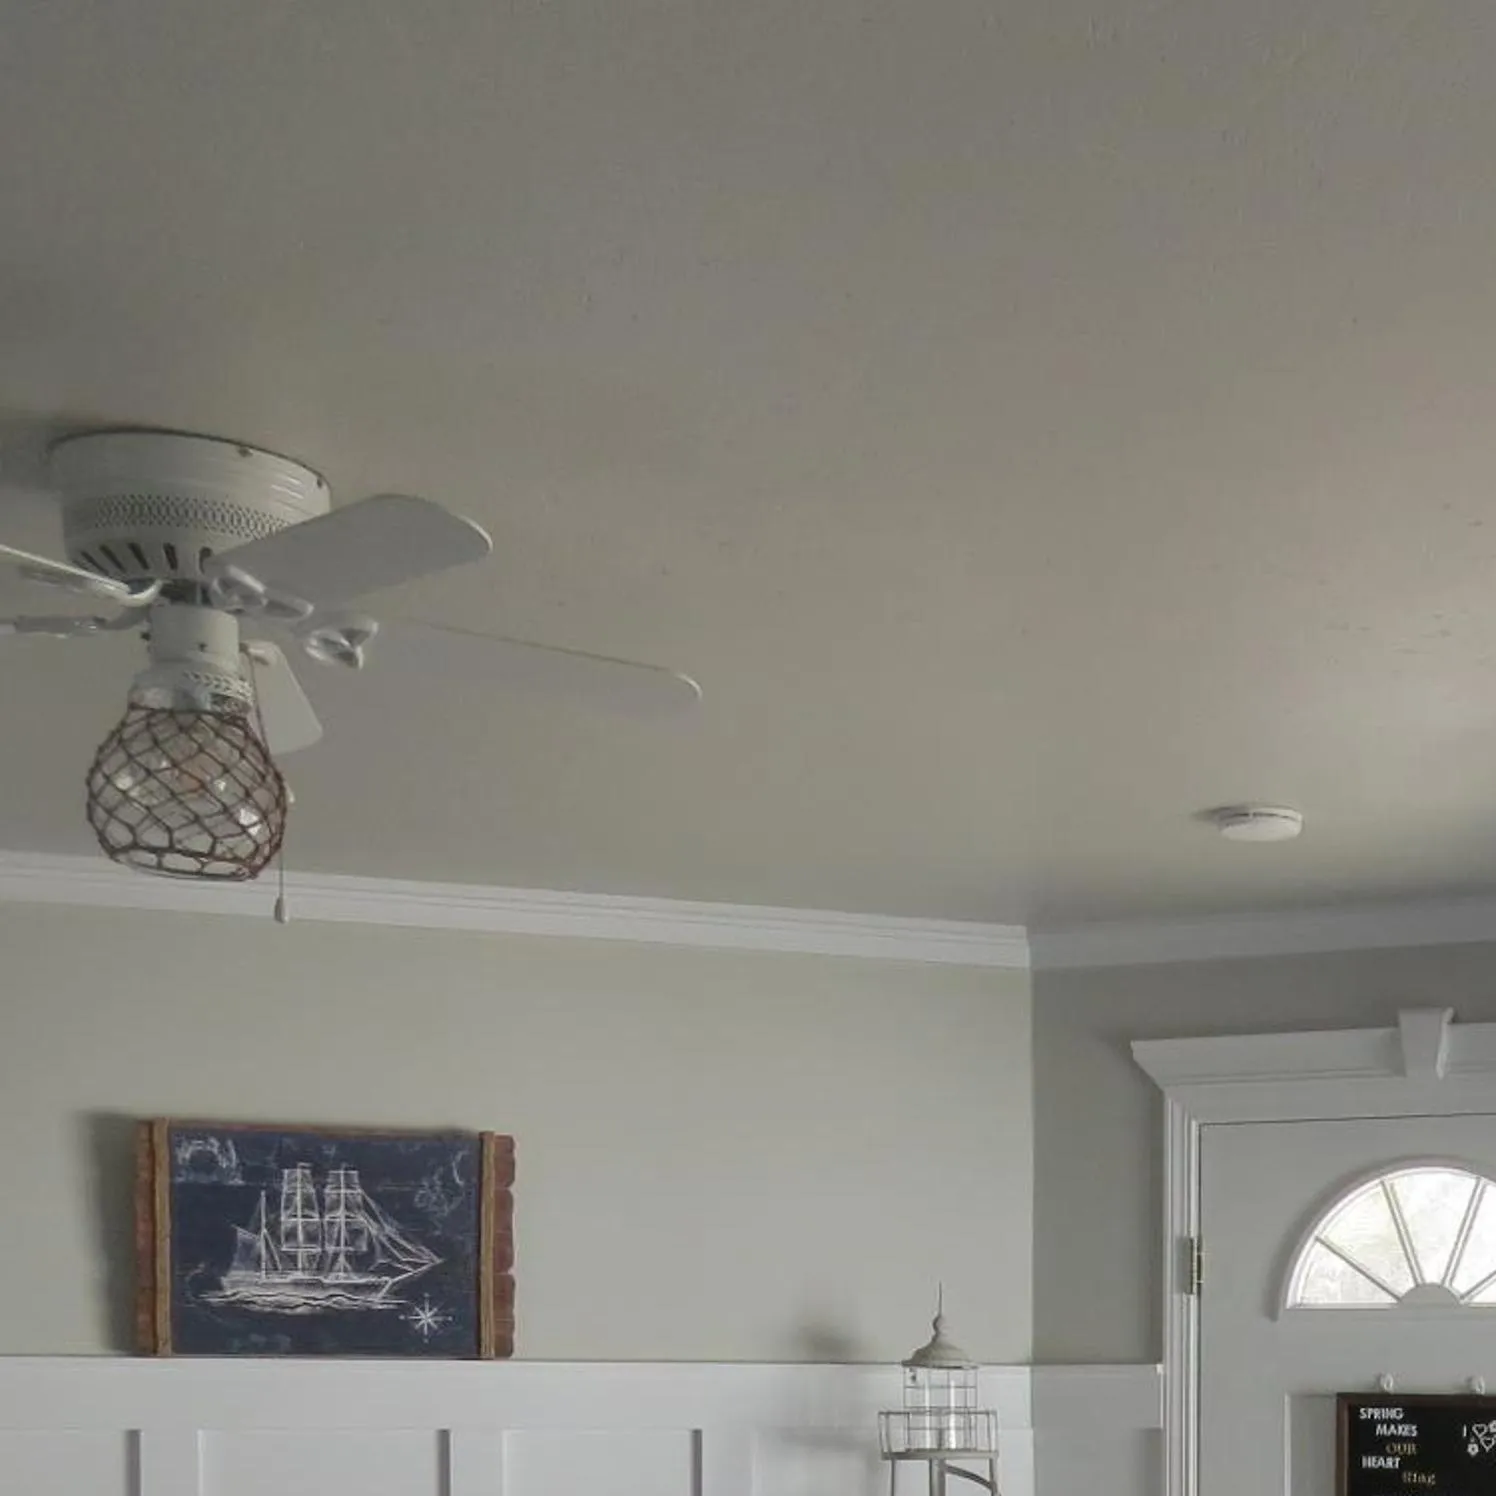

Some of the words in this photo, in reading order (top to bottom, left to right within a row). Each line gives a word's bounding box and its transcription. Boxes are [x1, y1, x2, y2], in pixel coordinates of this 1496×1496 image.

[1359, 1407, 1404, 1420] SPRING
[1375, 1423, 1418, 1437] MAKES
[1361, 1455, 1401, 1469] HEART
